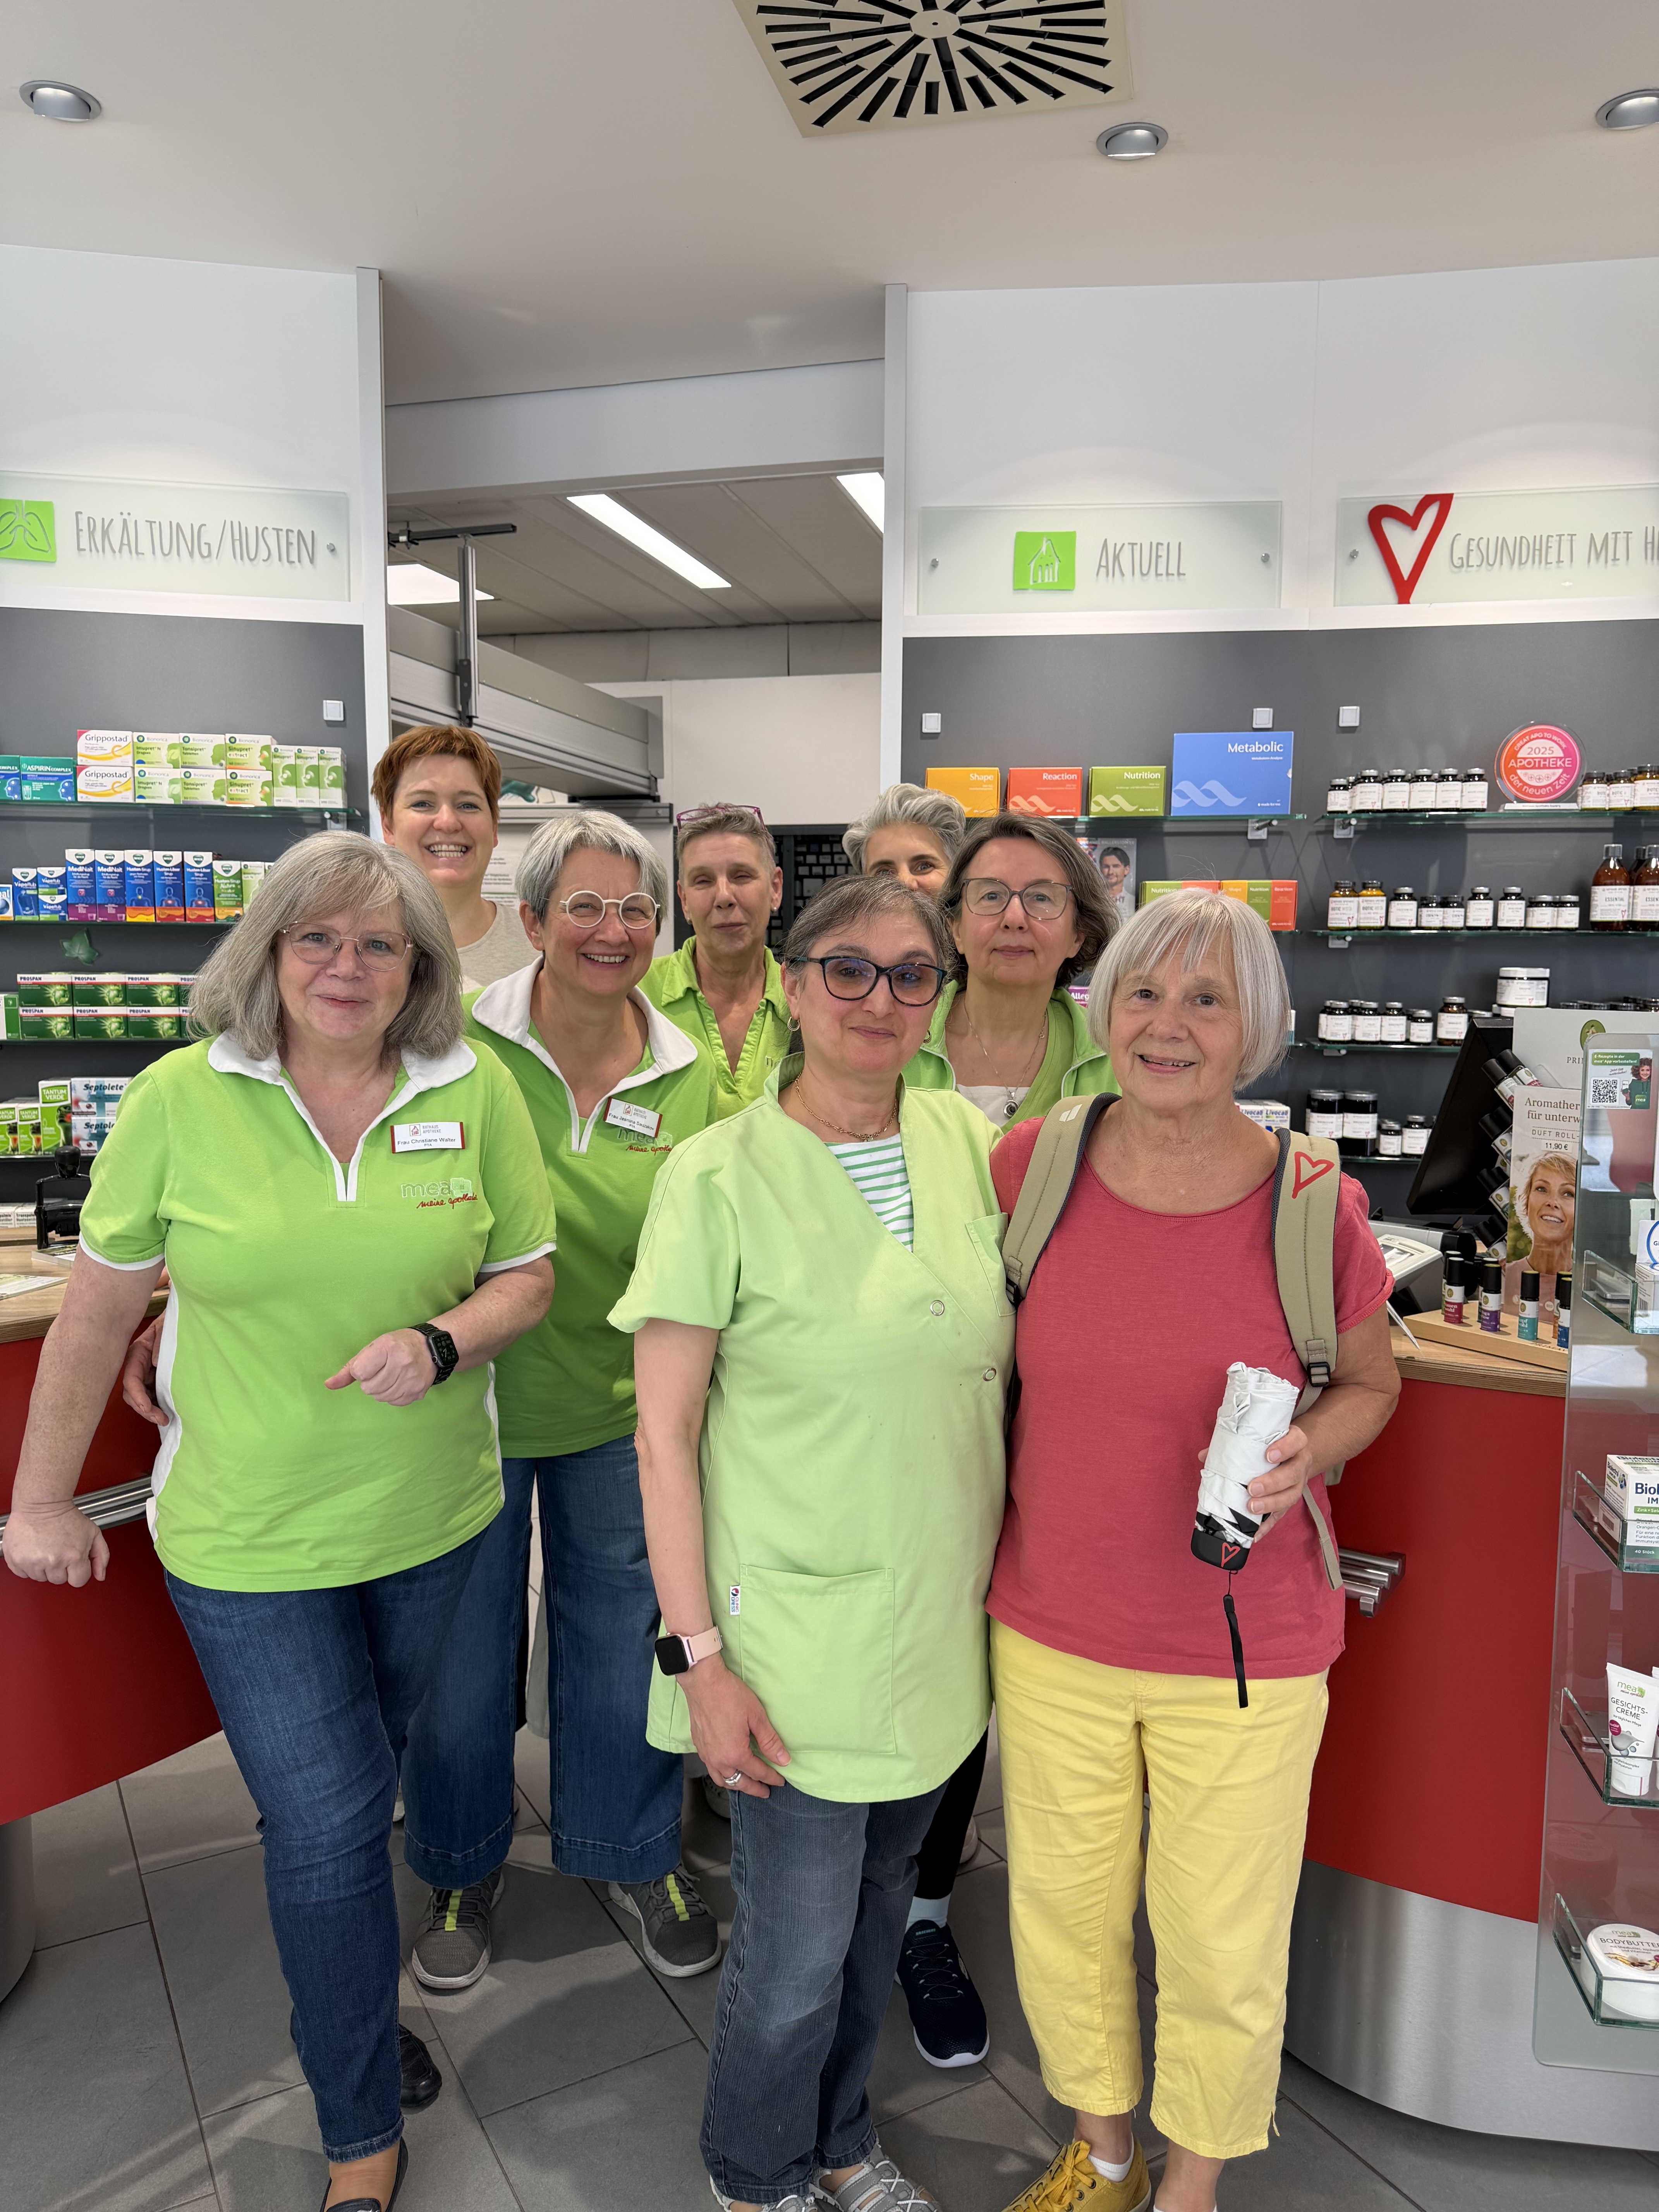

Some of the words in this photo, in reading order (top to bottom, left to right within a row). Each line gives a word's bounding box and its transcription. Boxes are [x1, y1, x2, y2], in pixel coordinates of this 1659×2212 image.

[1450, 533, 1577, 569] GESUNDHEIT
[1588, 531, 1633, 564] MIT
[1644, 526, 1659, 561] H
[1096, 538, 1187, 577] AKTUELL
[85, 734, 127, 743] Grippostad
[1514, 735, 1530, 751] GREAT
[1552, 735, 1567, 750] WORK
[1228, 741, 1284, 753] Metabolic
[1527, 747, 1554, 755] 2025
[1508, 757, 1572, 768] APOTHEKE
[85, 770, 127, 779] Grippostad
[969, 773, 994, 782] Shape
[1510, 774, 1523, 788] der
[1523, 785, 1553, 795] neuen
[1553, 773, 1570, 790] Zeit
[83, 1084, 124, 1092] Septolete
[1527, 1110, 1542, 1120] für
[401, 1181, 452, 1198] mea
[416, 1198, 447, 1209] meine
[1617, 1681, 1637, 1693] mea
[1611, 1697, 1648, 1714] GESICHTS-
[1616, 1706, 1641, 1720] CREME
